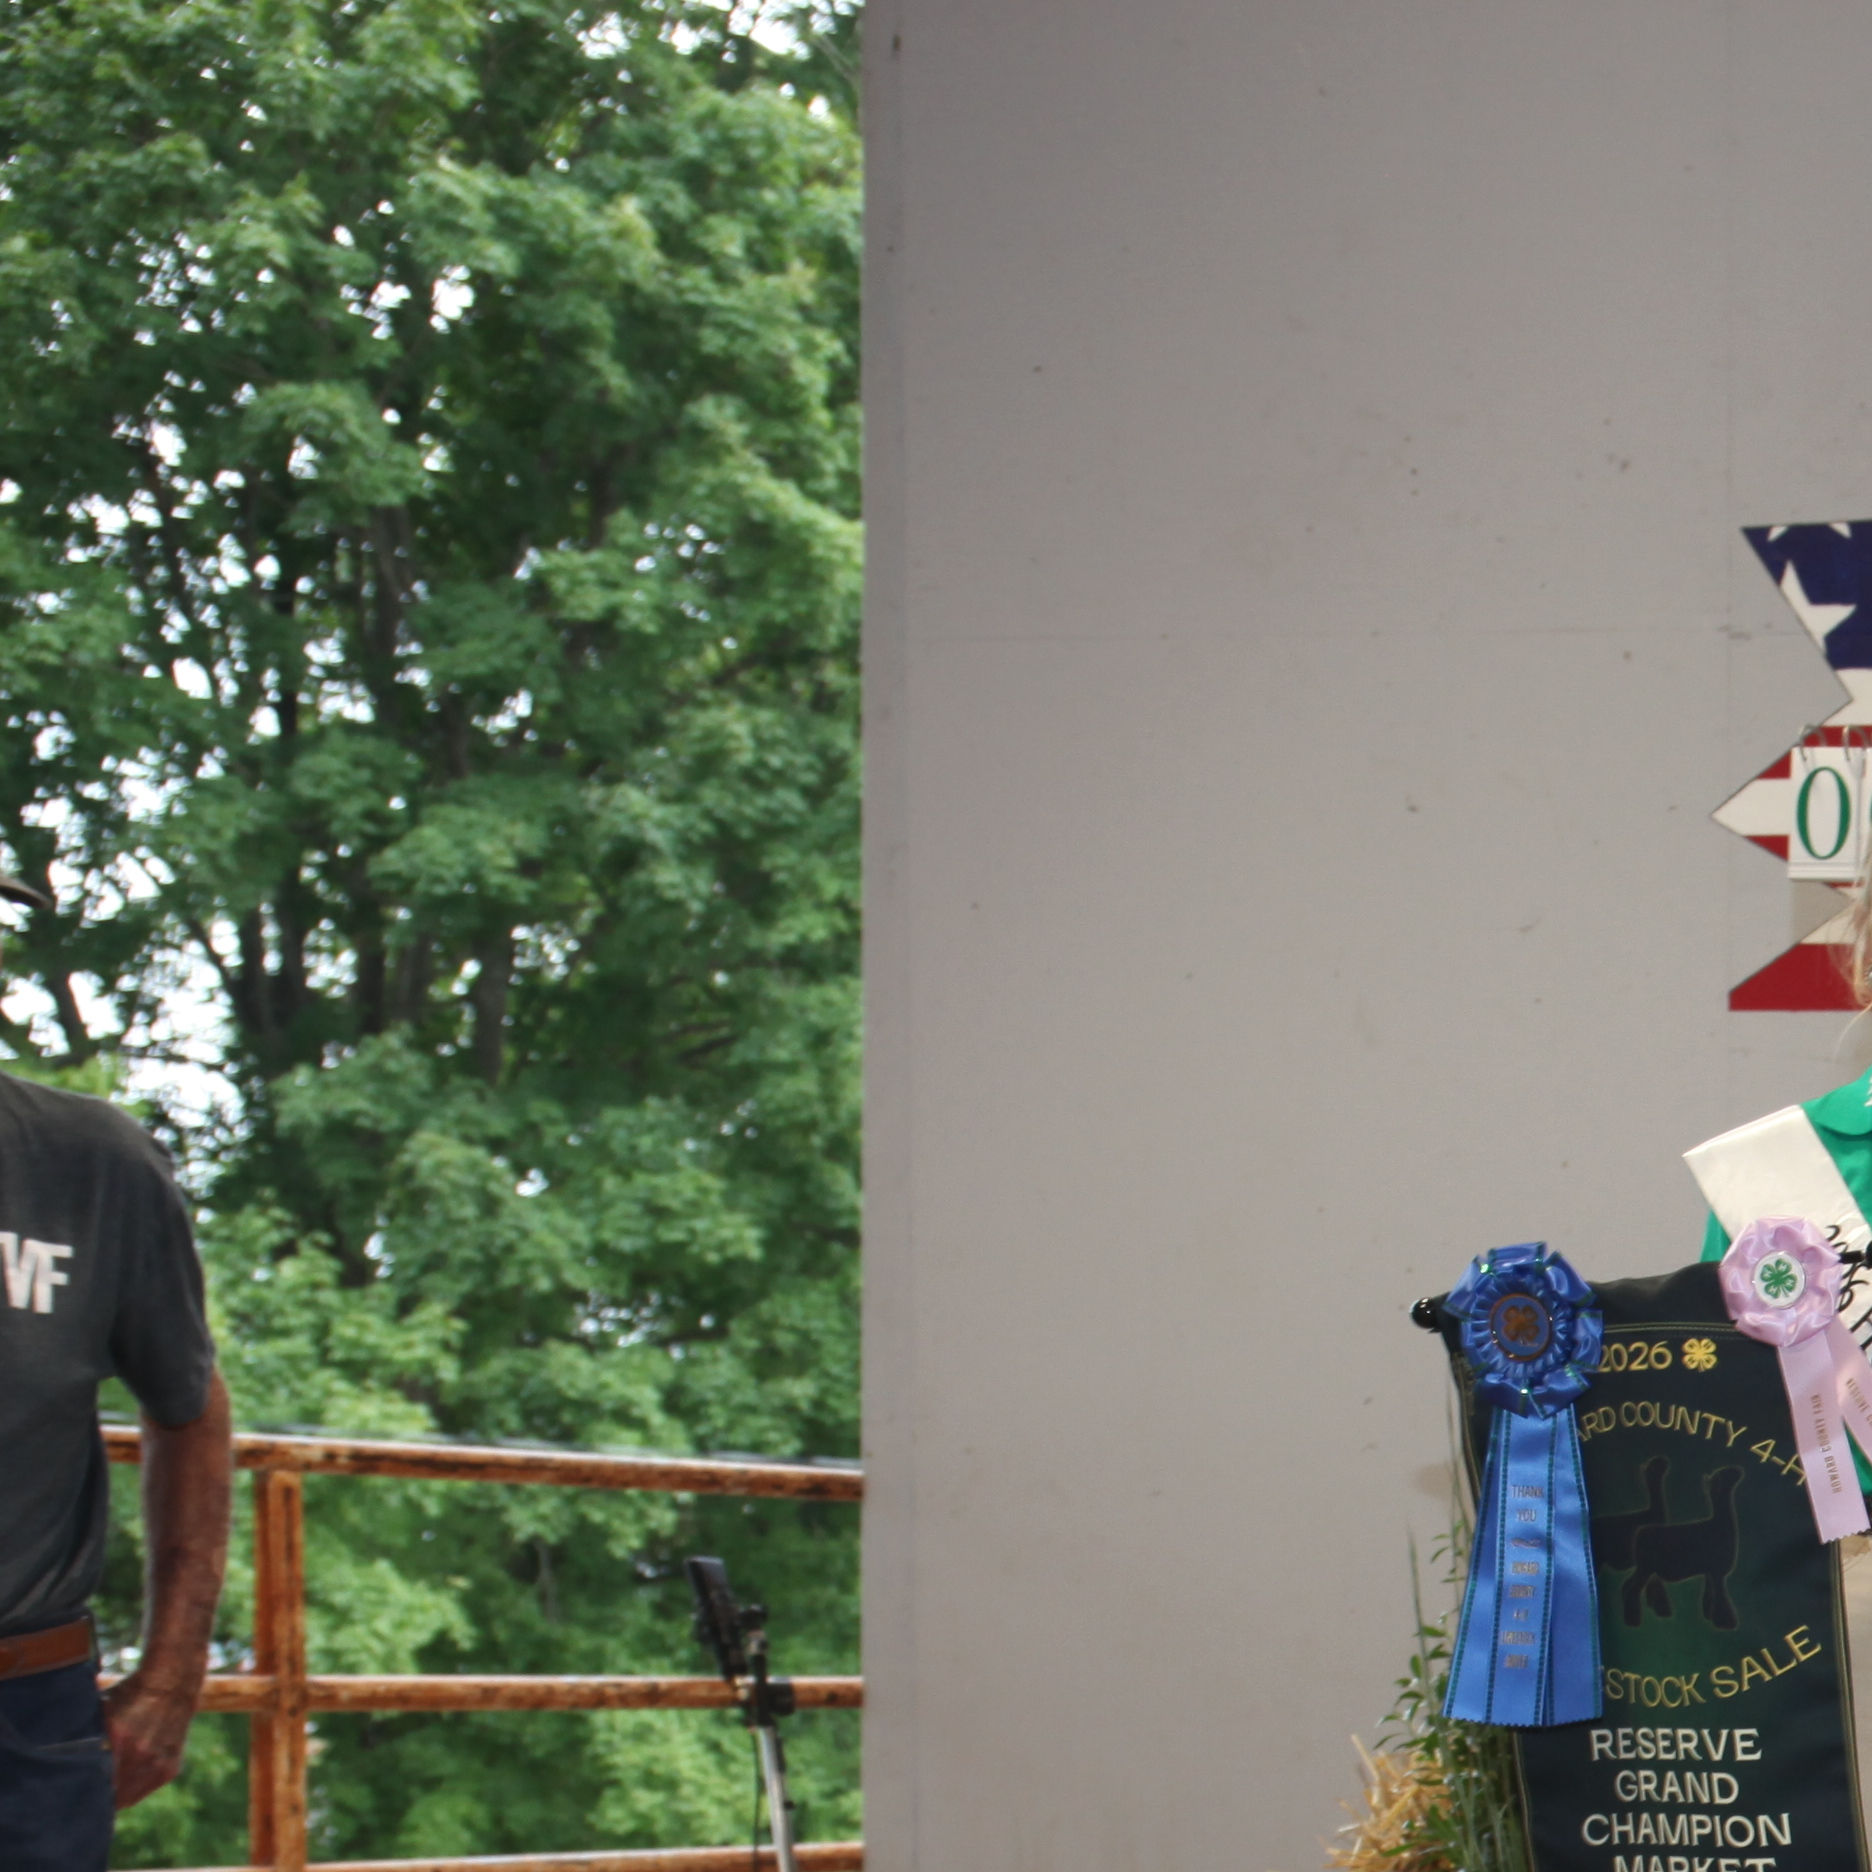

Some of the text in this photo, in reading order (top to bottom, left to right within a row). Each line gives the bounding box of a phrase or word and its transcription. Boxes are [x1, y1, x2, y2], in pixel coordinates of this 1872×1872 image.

[1598, 1340, 1673, 1373] 2026
[1620, 1400, 1748, 1448] COUNTY
[1602, 1624, 1822, 1708] STOCK SALE
[1589, 1727, 1763, 1762] RESERVE
[1614, 1769, 1740, 1805] GRAND
[1581, 1812, 1793, 1848] CHAMPION
